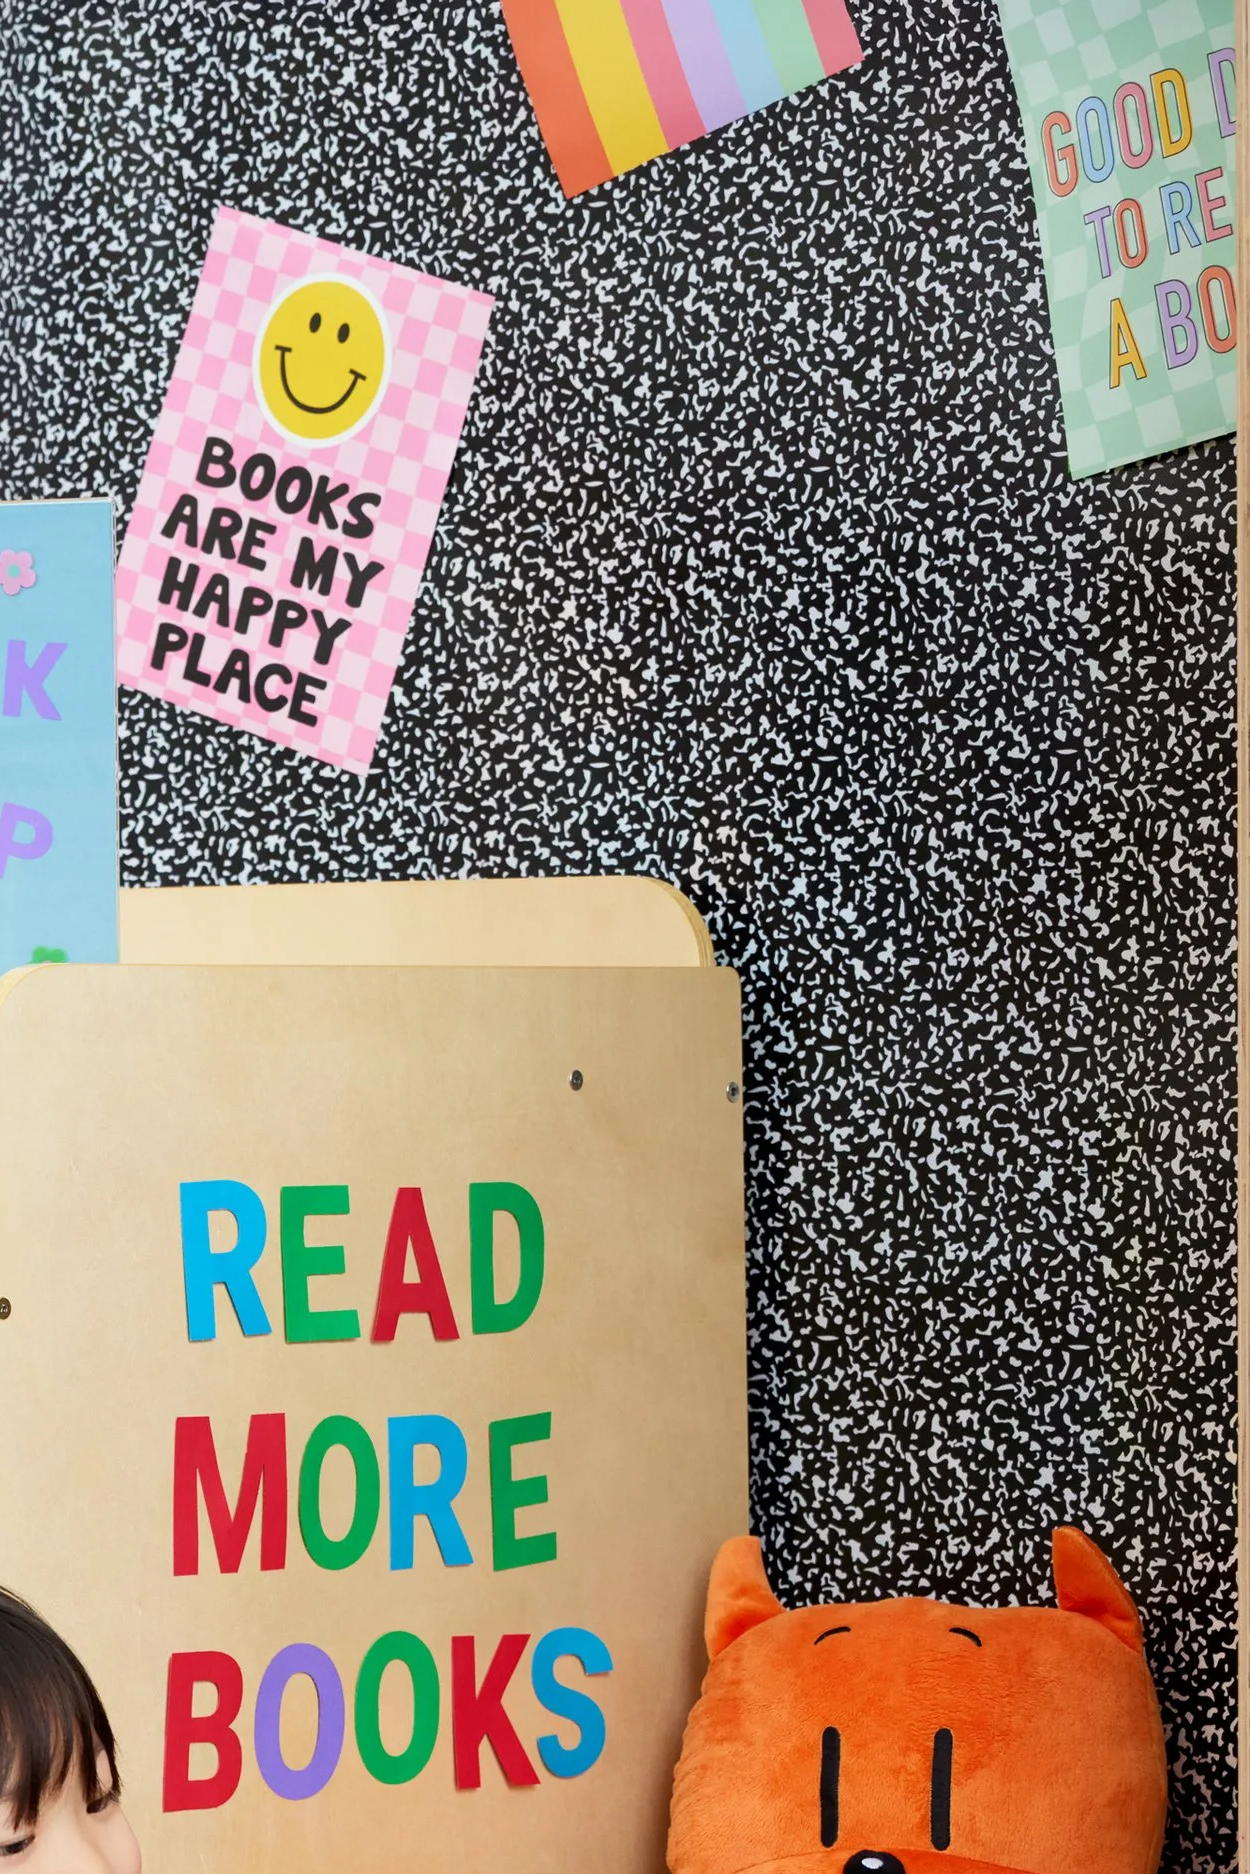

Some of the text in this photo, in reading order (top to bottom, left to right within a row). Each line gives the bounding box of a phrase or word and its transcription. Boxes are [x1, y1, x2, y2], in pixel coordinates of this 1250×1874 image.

[1040, 67, 1193, 198] GOOD
[1083, 198, 1147, 279] TO
[1109, 297, 1148, 389] A
[196, 436, 381, 539] BOOKS
[160, 493, 385, 608] ARE MY
[158, 556, 352, 665] HAPPY
[150, 622, 328, 727] PLACE
[179, 1179, 546, 1344] READ
[172, 1411, 557, 1577] MORE
[162, 1627, 613, 1813] BOOKS
